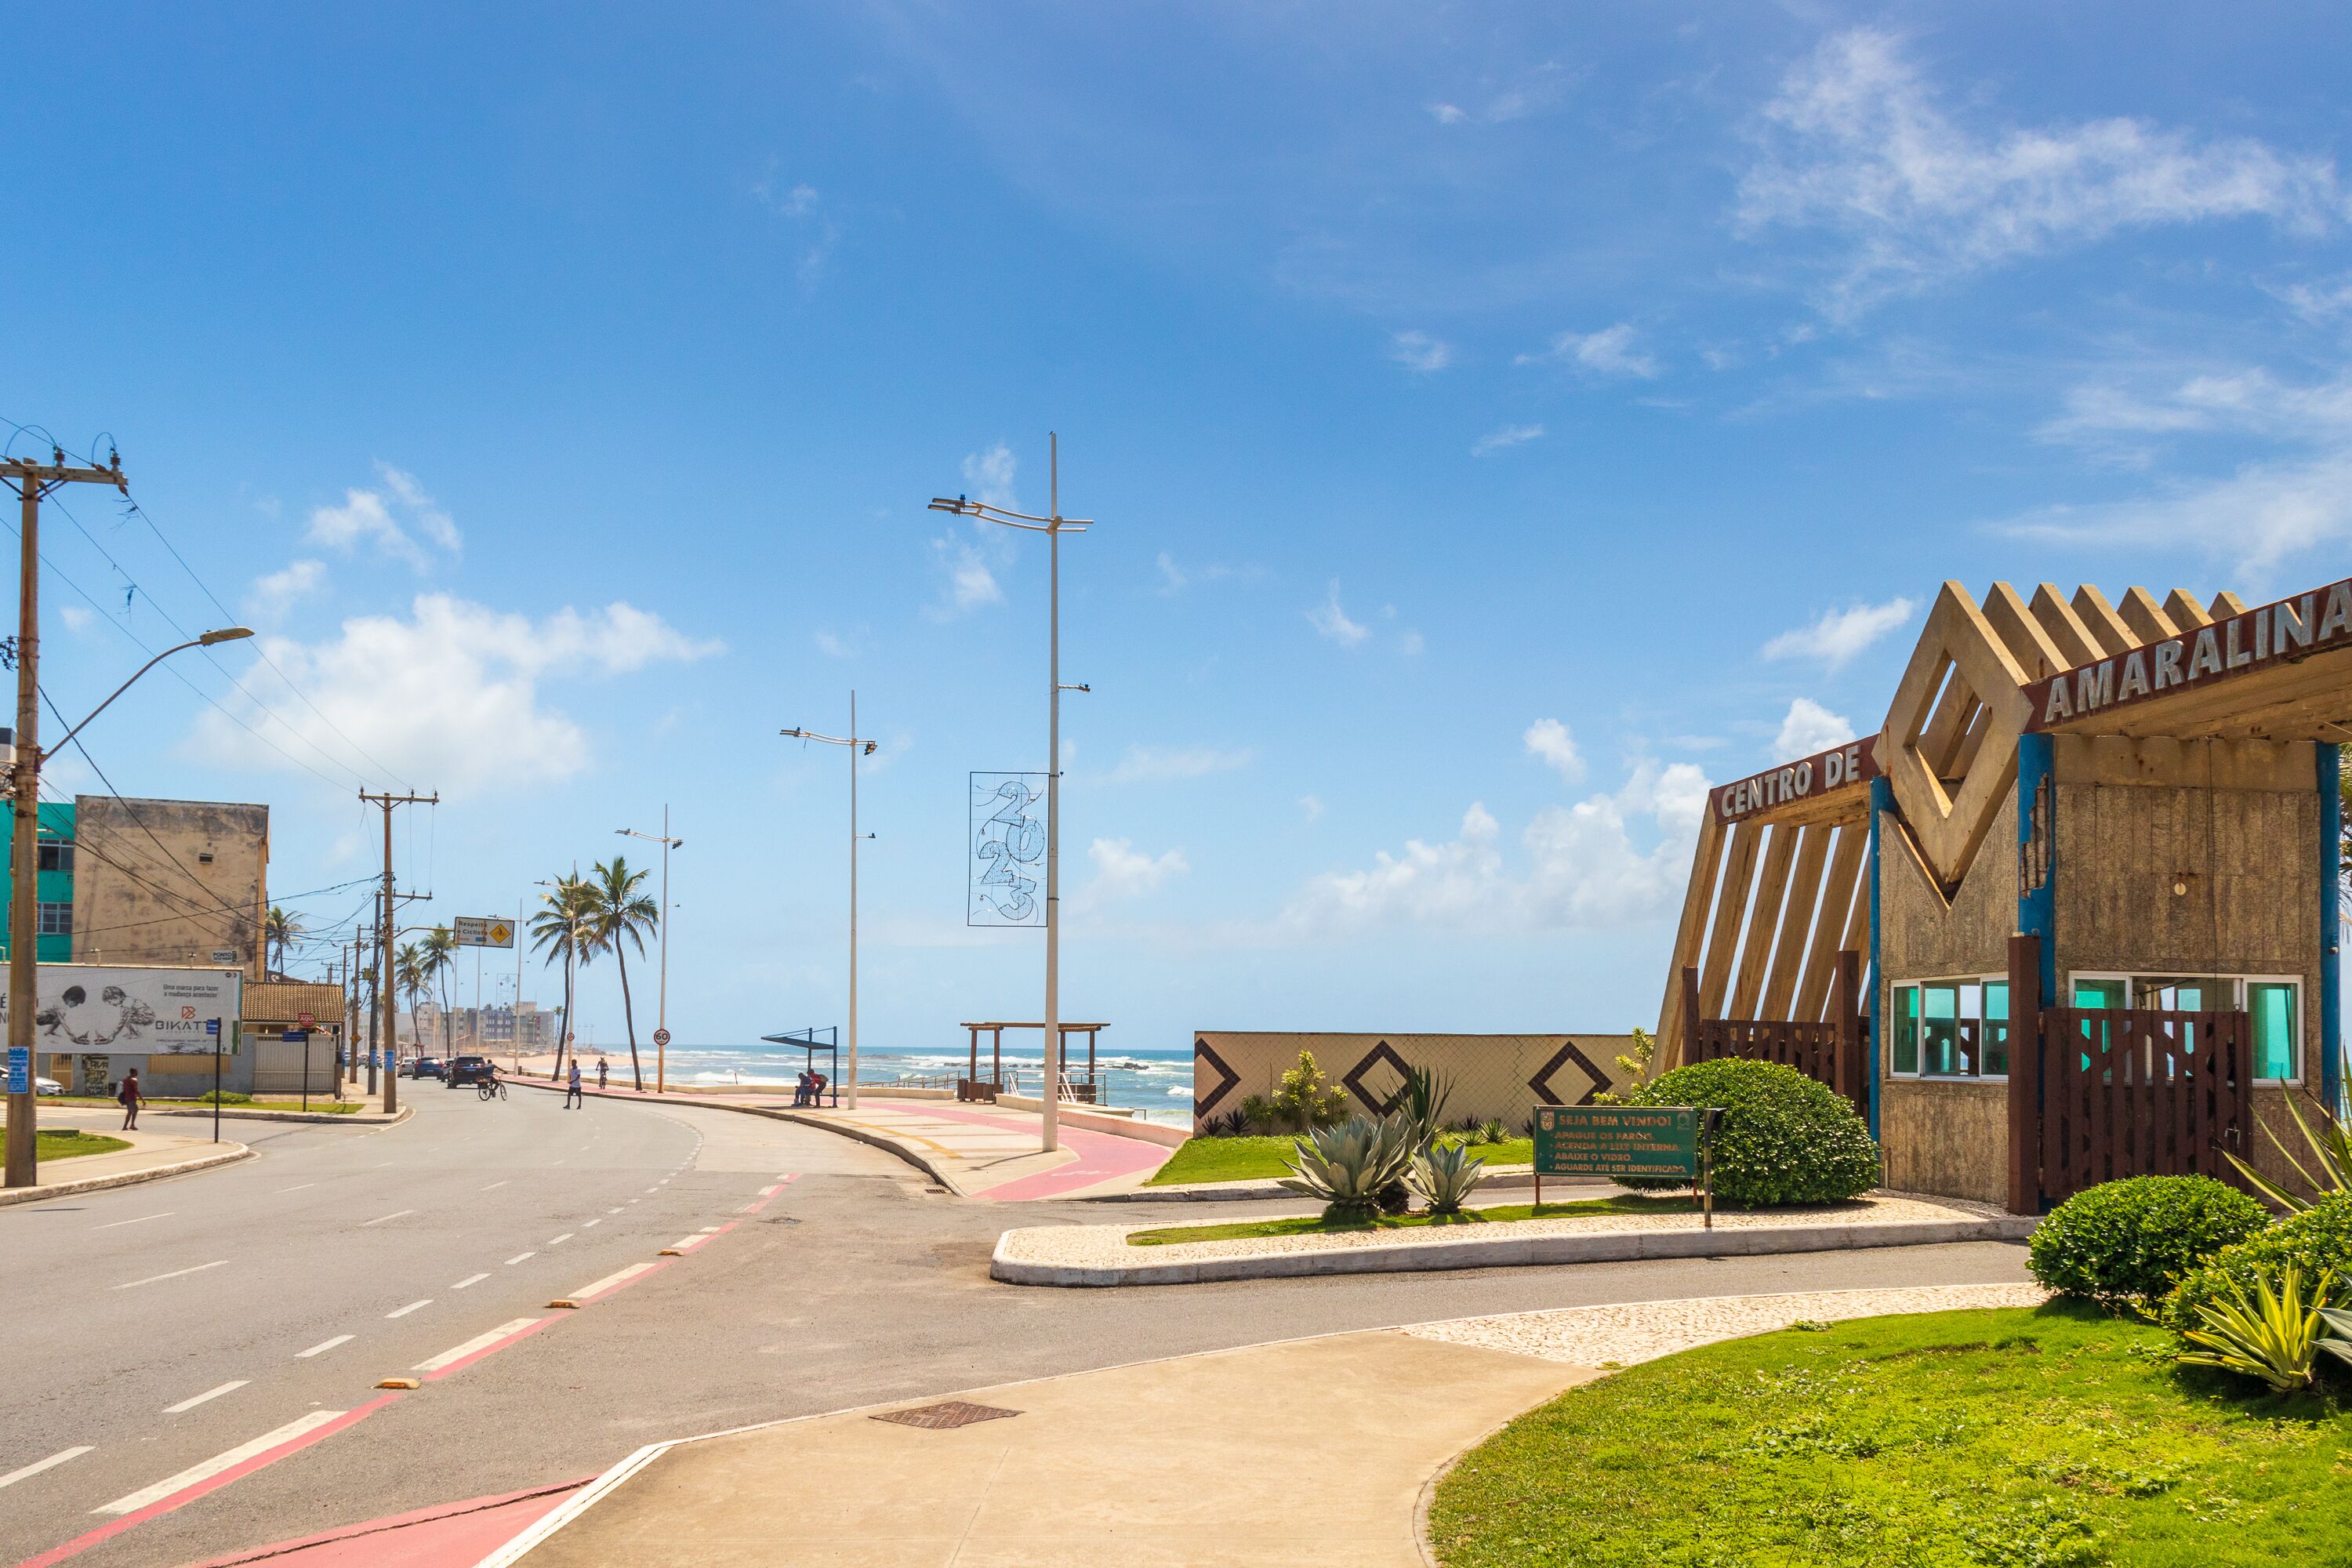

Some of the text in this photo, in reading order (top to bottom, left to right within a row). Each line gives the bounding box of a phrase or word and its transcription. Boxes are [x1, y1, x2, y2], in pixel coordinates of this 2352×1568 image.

[1722, 582, 2352, 817] CENTRO DE AMARALINA
[155, 1020, 207, 1030] BIKAT
[1559, 1115, 1671, 1127] SEJA BEM VINDO!
[1555, 1163, 1593, 1171] AGUARDE
